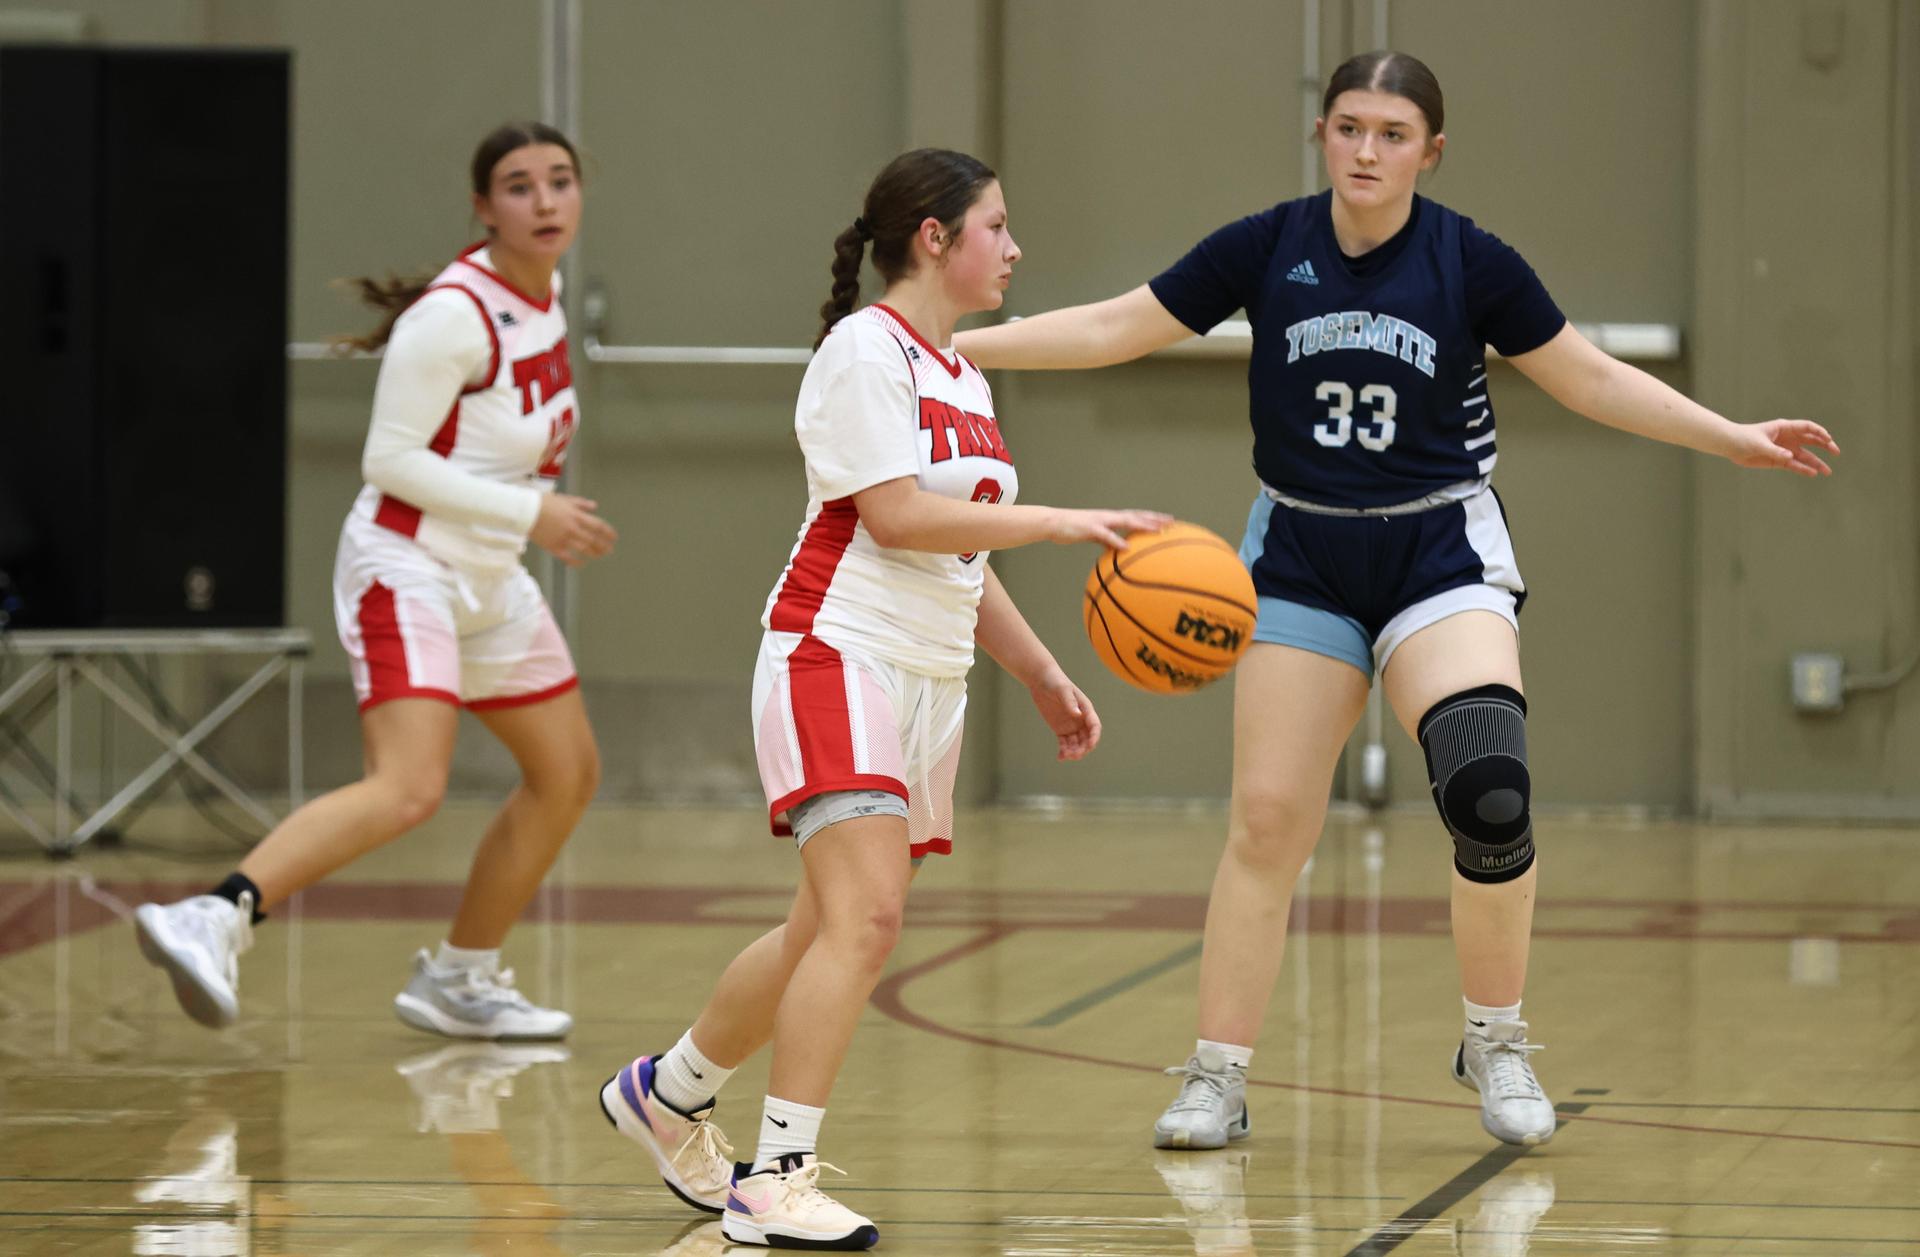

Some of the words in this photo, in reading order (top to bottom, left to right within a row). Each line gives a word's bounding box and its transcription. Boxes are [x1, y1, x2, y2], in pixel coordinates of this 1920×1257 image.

[1286, 311, 1436, 379] YOSEMITE
[918, 395, 1014, 466] TRIB
[1313, 381, 1397, 452] 33
[1481, 842, 1529, 868] Mueller
